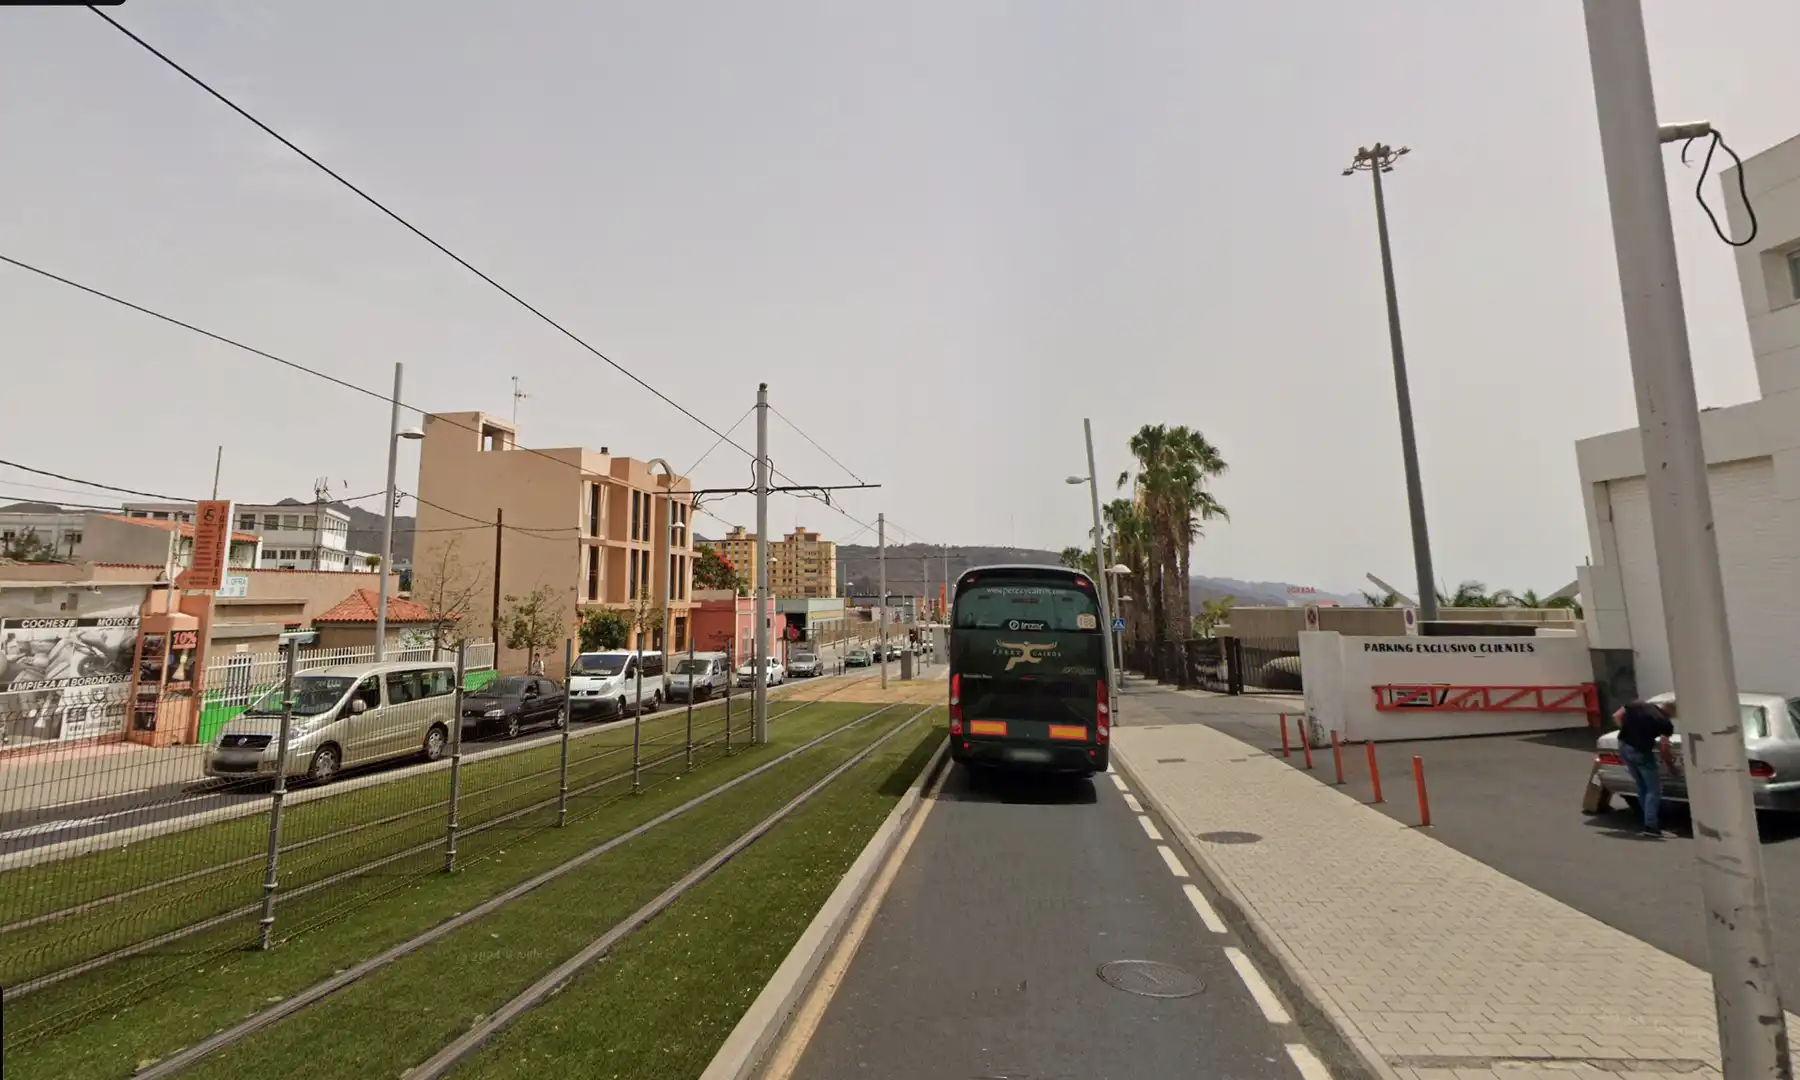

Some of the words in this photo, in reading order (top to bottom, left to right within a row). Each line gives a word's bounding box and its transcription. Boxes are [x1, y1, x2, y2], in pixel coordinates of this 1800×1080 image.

[21, 619, 67, 629] COCHES
[96, 618, 130, 627] MOTOS
[1364, 642, 1414, 653] PARKING
[1416, 643, 1477, 653] EXCLUSIVO
[1480, 643, 1535, 653] CLIENTES
[7, 679, 56, 692] LIMPIEZA
[71, 675, 123, 687] BORDADOS
